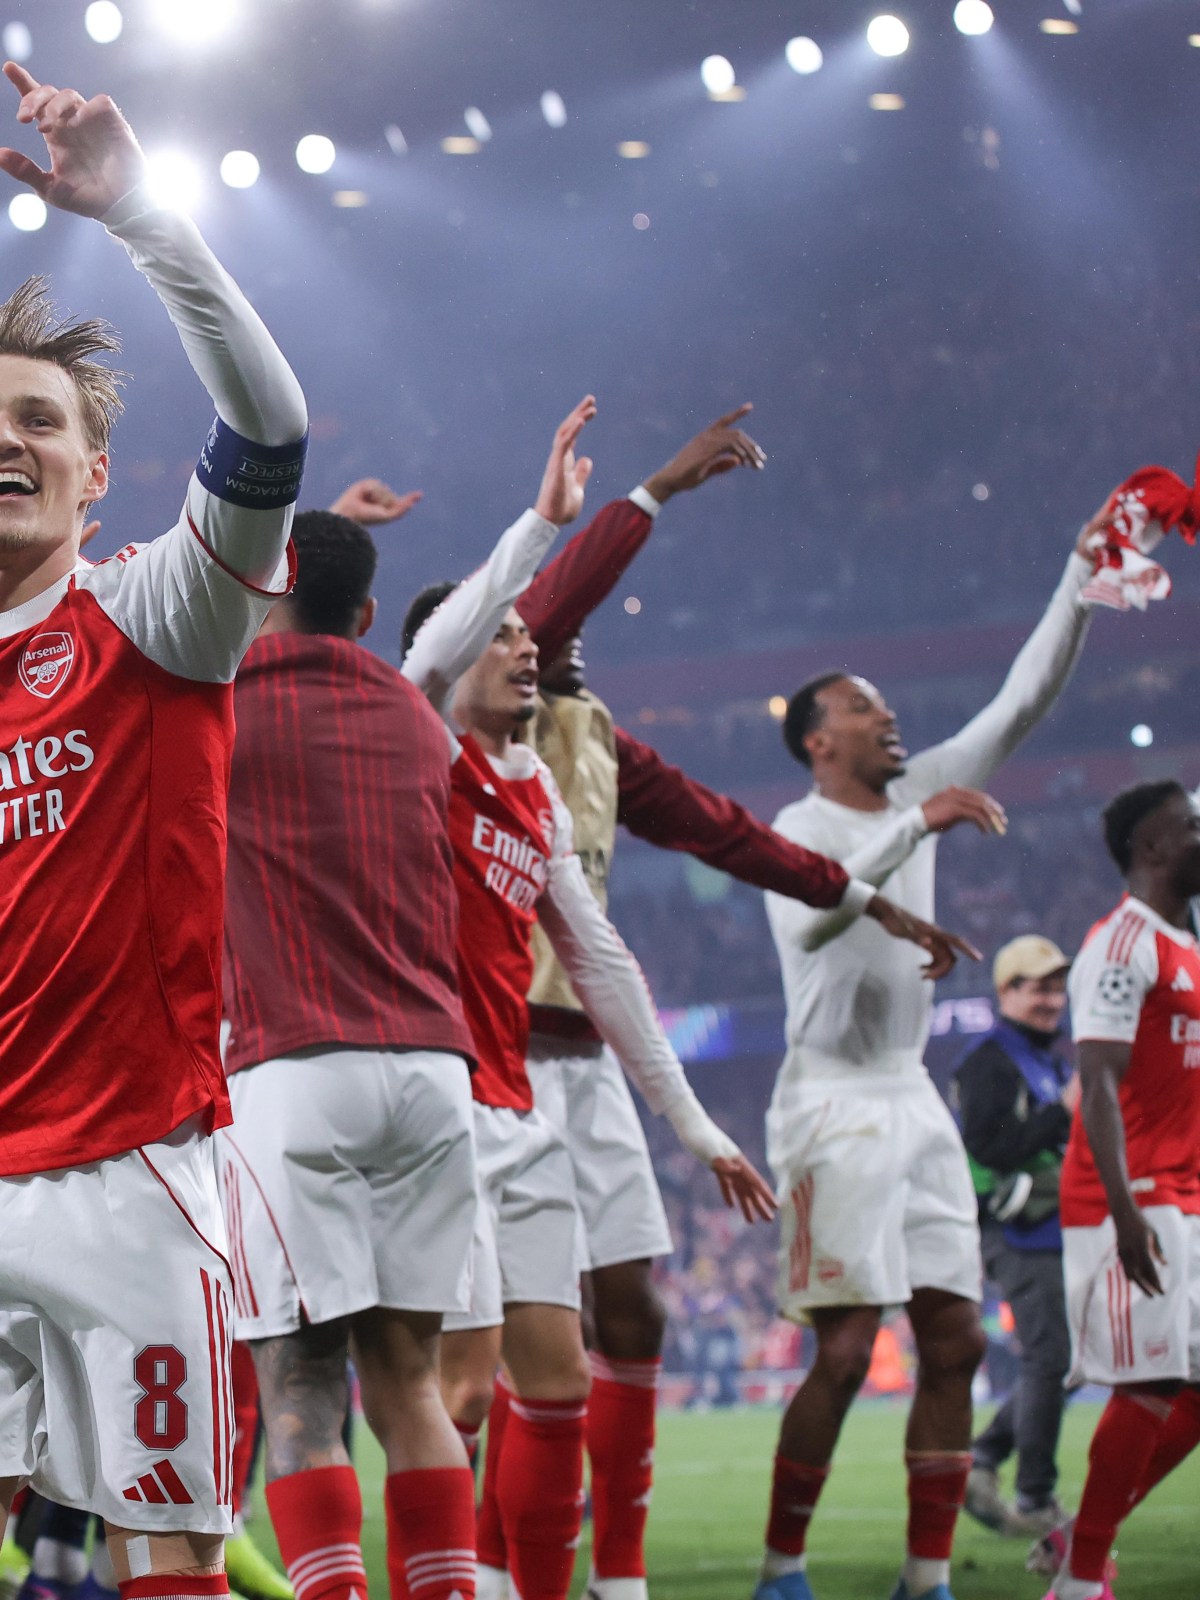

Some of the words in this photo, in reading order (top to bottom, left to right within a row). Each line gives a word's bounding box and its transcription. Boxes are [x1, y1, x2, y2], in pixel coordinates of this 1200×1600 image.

[240, 461, 300, 478] RESPECT
[226, 476, 279, 496] RACISM
[25, 642, 66, 662] Arsenal
[133, 1344, 188, 1451] 8
